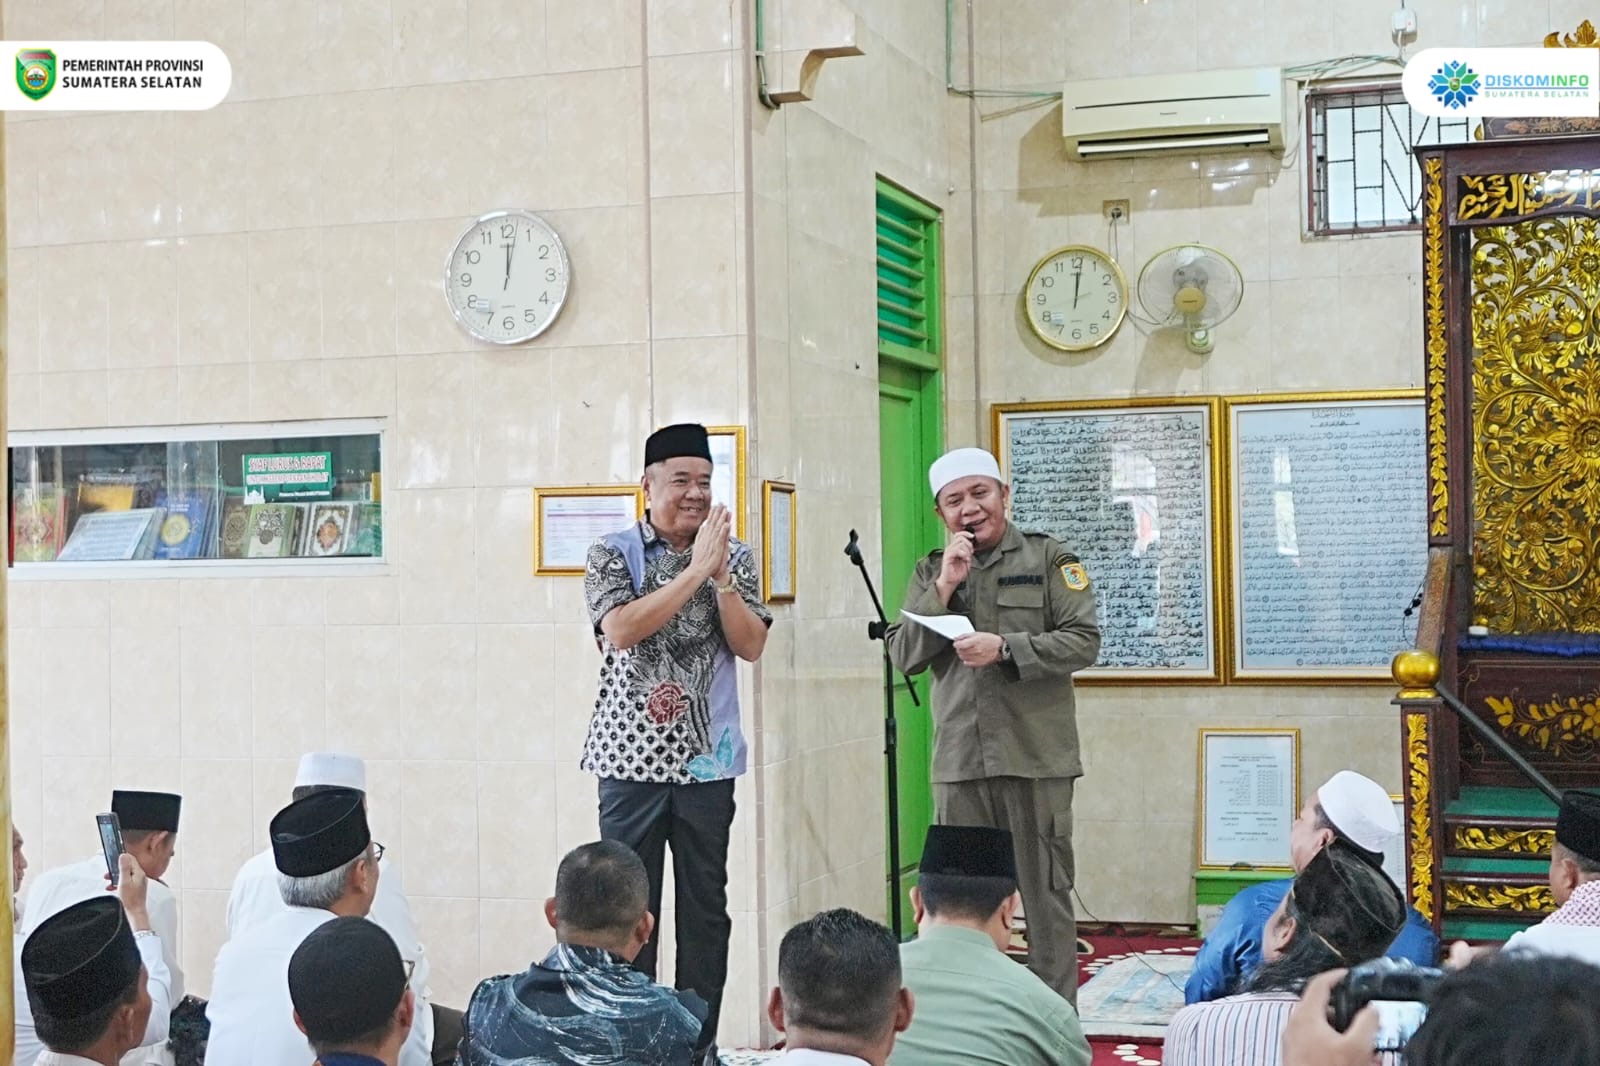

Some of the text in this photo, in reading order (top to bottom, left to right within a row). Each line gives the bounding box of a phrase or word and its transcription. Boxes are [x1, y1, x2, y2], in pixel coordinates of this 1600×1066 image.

[481, 230, 492, 245] 11
[500, 223, 516, 239] 12
[526, 228, 532, 243] 1
[465, 249, 481, 265] 10
[538, 244, 550, 260] 2
[1055, 262, 1064, 273] 11
[1071, 256, 1084, 269] 12
[1092, 260, 1098, 273] 1
[460, 272, 473, 288] 9
[545, 267, 557, 283] 3
[1102, 274, 1112, 286] 2
[1041, 276, 1055, 288] 10
[467, 294, 479, 310] 8
[538, 291, 550, 305] 4
[1037, 293, 1047, 305] 9
[1107, 292, 1118, 304] 3
[486, 311, 496, 326] 7
[524, 308, 536, 323] 5
[1042, 311, 1052, 323] 8
[1101, 309, 1111, 320] 4
[502, 315, 515, 331] 6
[1056, 324, 1065, 335] 7
[1089, 323, 1100, 335] 5
[1071, 328, 1082, 340] 6
